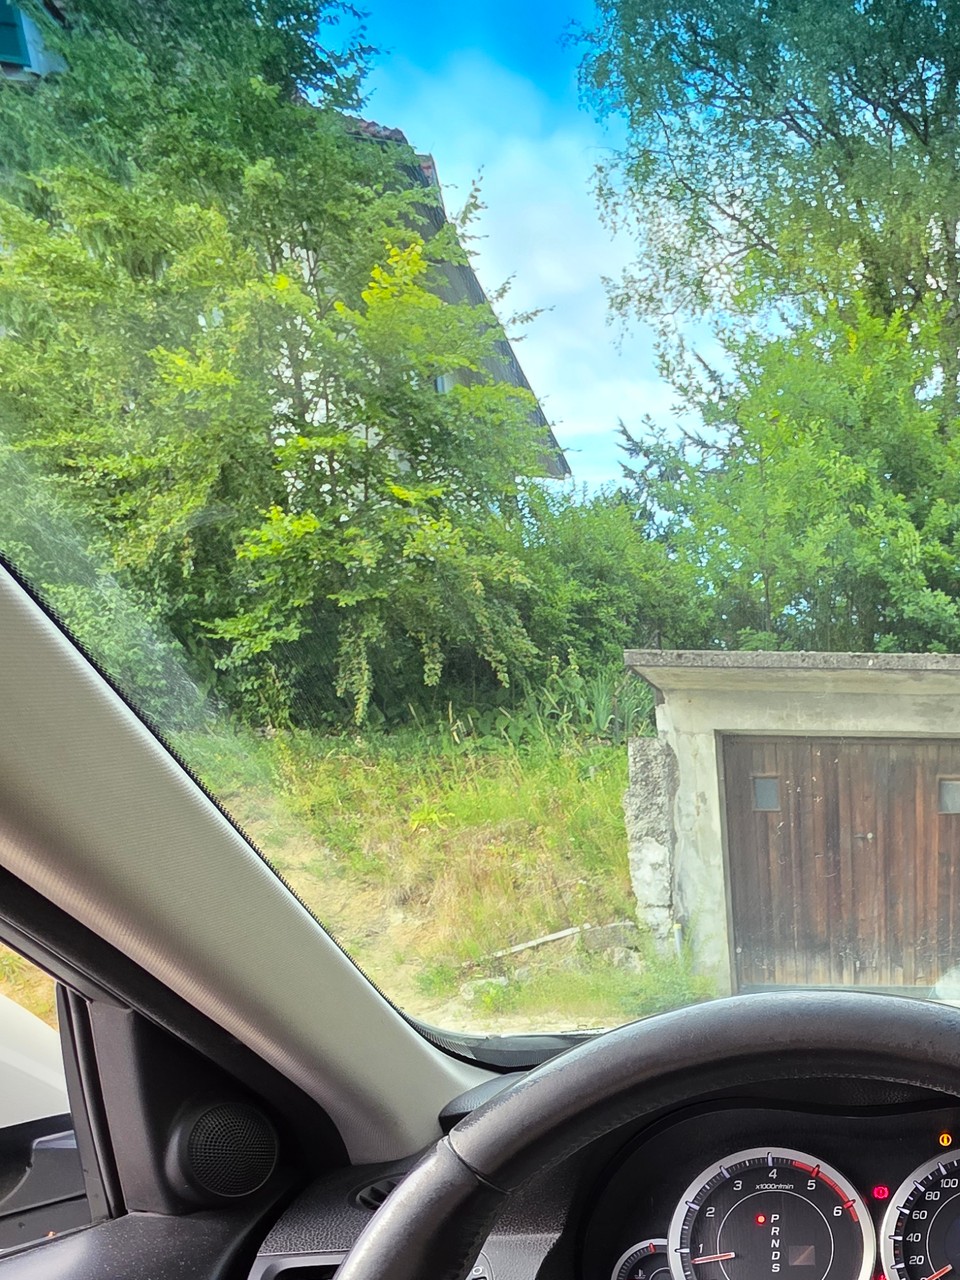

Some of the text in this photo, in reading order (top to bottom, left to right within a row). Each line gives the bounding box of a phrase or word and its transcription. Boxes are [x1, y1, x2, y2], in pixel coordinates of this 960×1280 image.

[769, 1169, 778, 1179] 4
[733, 1181, 743, 1191] 3
[807, 1180, 816, 1190] 5
[940, 1178, 958, 1188] 100
[925, 1191, 940, 1200] 80
[705, 1207, 715, 1217] 2
[833, 1206, 842, 1217] 6
[912, 1210, 927, 1220] 60
[771, 1214, 780, 1223] P
[771, 1227, 780, 1236] R
[906, 1233, 921, 1242] 40
[771, 1239, 780, 1248] N
[699, 1244, 704, 1254] 1
[771, 1252, 780, 1260] D
[909, 1255, 924, 1265] 20
[771, 1264, 780, 1273] S
